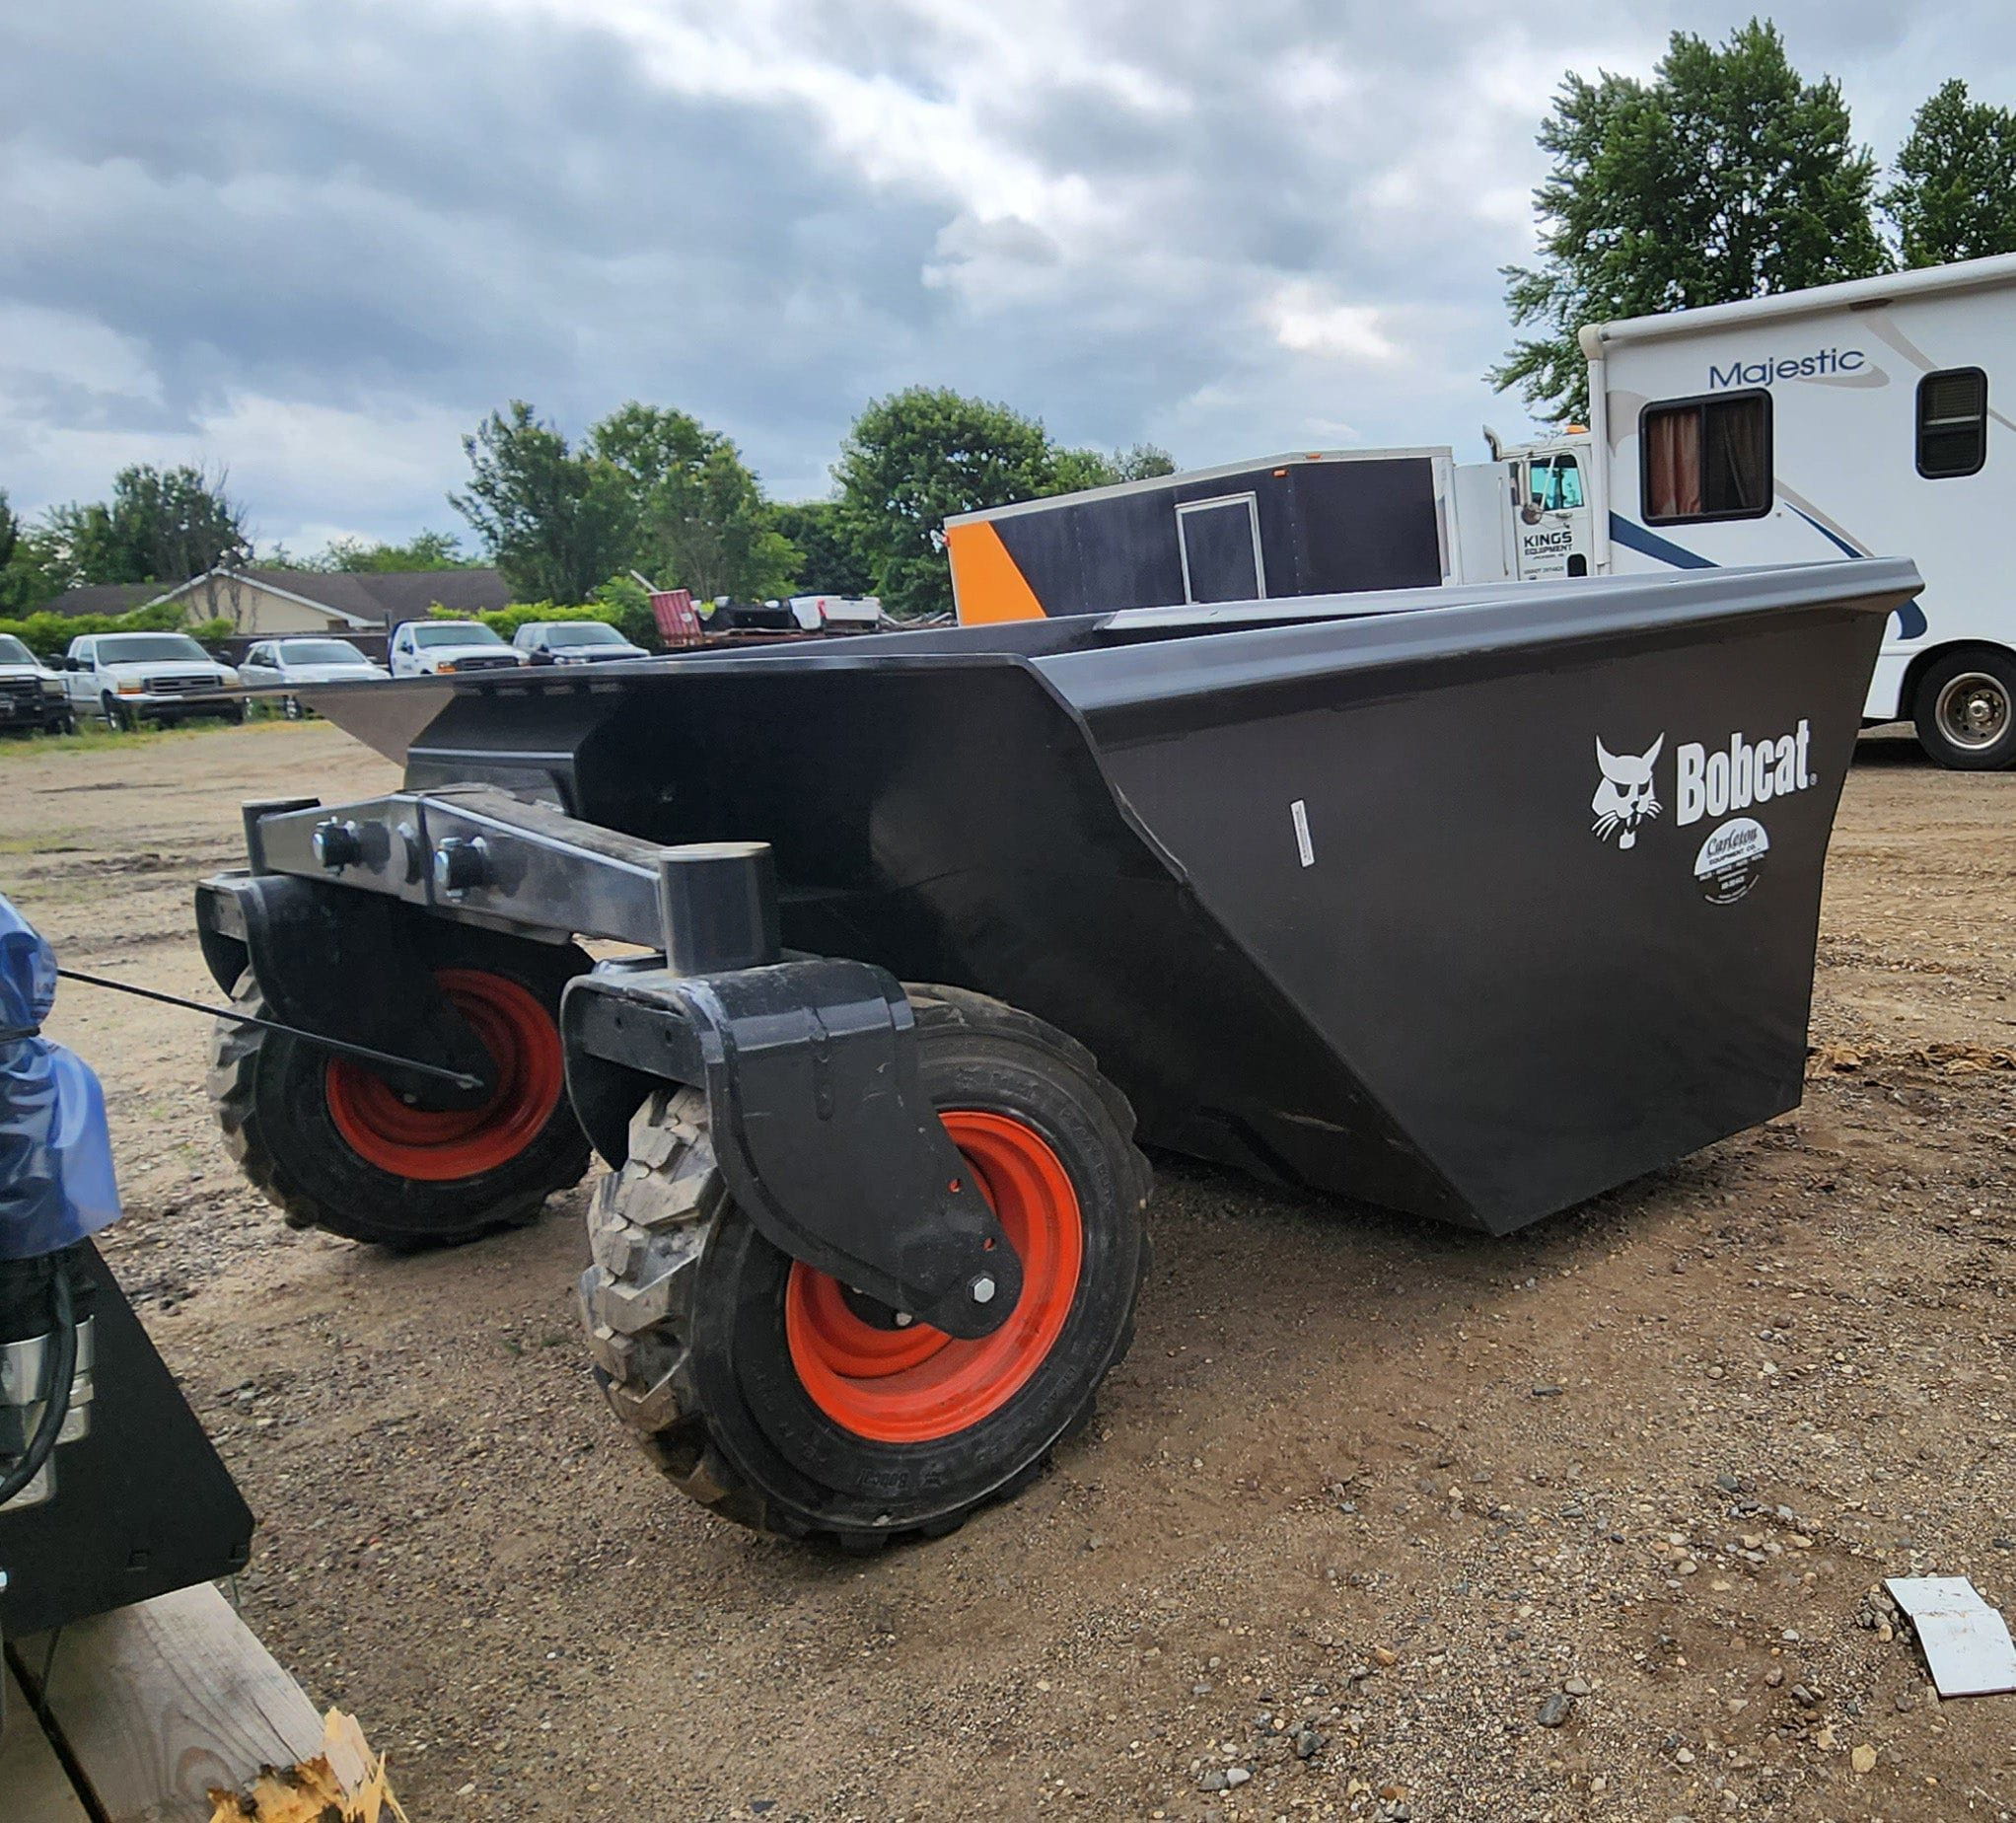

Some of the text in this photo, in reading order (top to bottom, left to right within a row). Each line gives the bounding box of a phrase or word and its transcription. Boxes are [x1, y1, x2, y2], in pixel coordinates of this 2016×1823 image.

[1709, 347, 1865, 389] Majestic
[1524, 531, 1572, 547] KINGS
[1525, 544, 1572, 555] EQUIPMENT
[1677, 718, 1809, 827] Bobcat
[1707, 827, 1758, 857] Carleton
